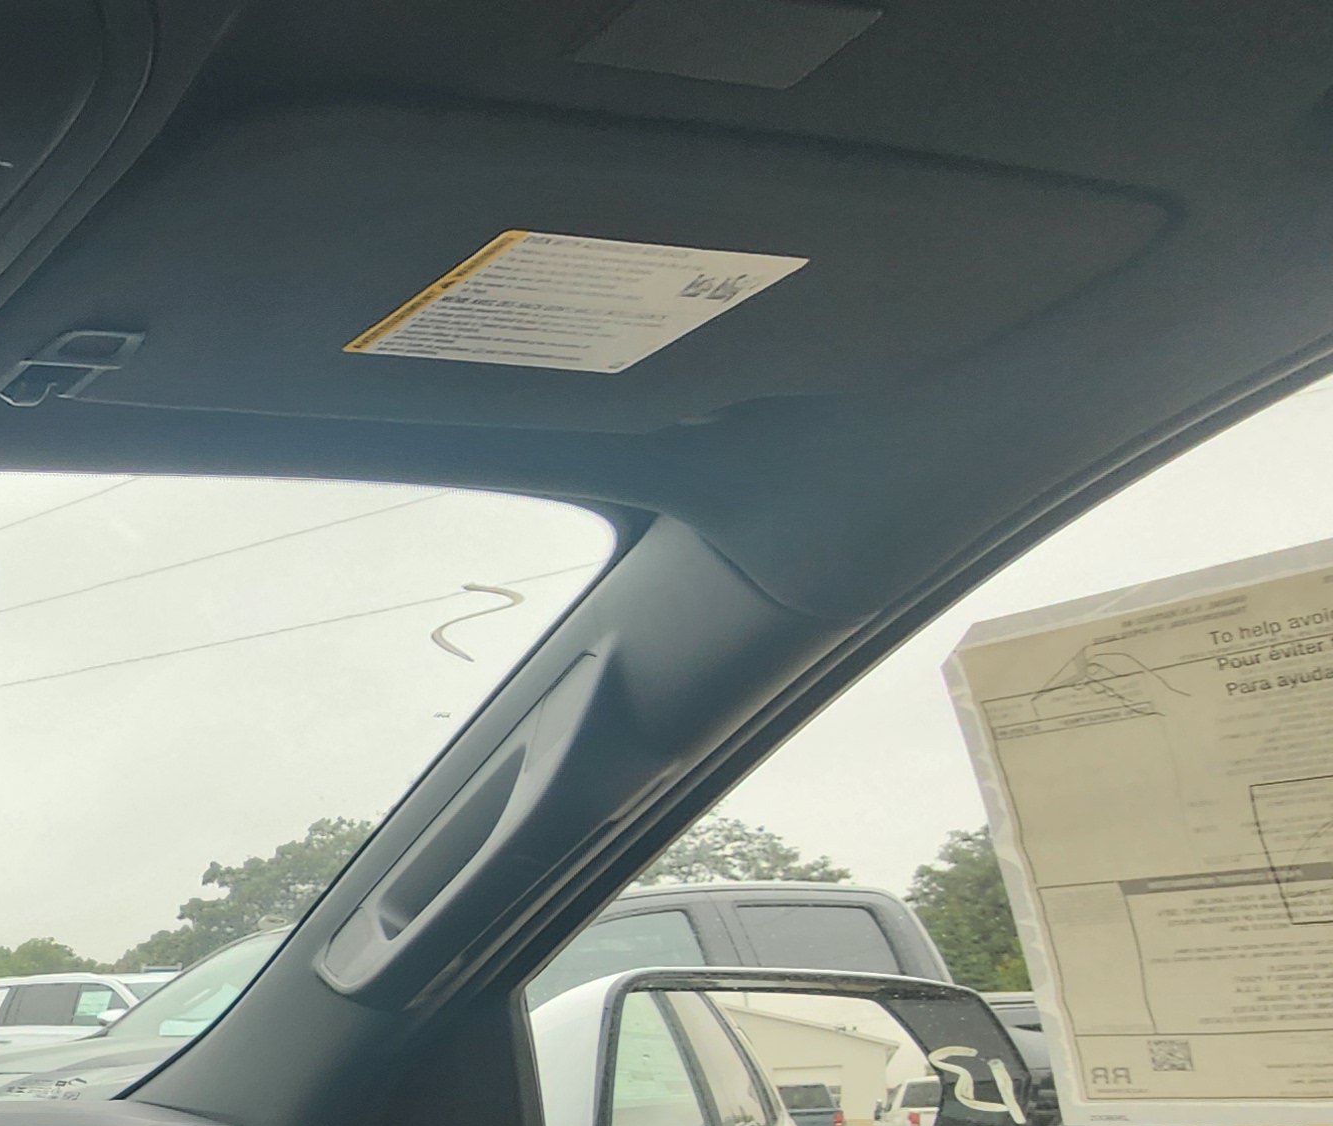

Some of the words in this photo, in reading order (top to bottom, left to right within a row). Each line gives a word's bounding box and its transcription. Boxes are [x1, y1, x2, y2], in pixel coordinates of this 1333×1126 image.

[1208, 630, 1233, 645] To
[1238, 621, 1281, 639] help
[1216, 653, 1262, 671] Pour
[1225, 678, 1272, 696] Para
